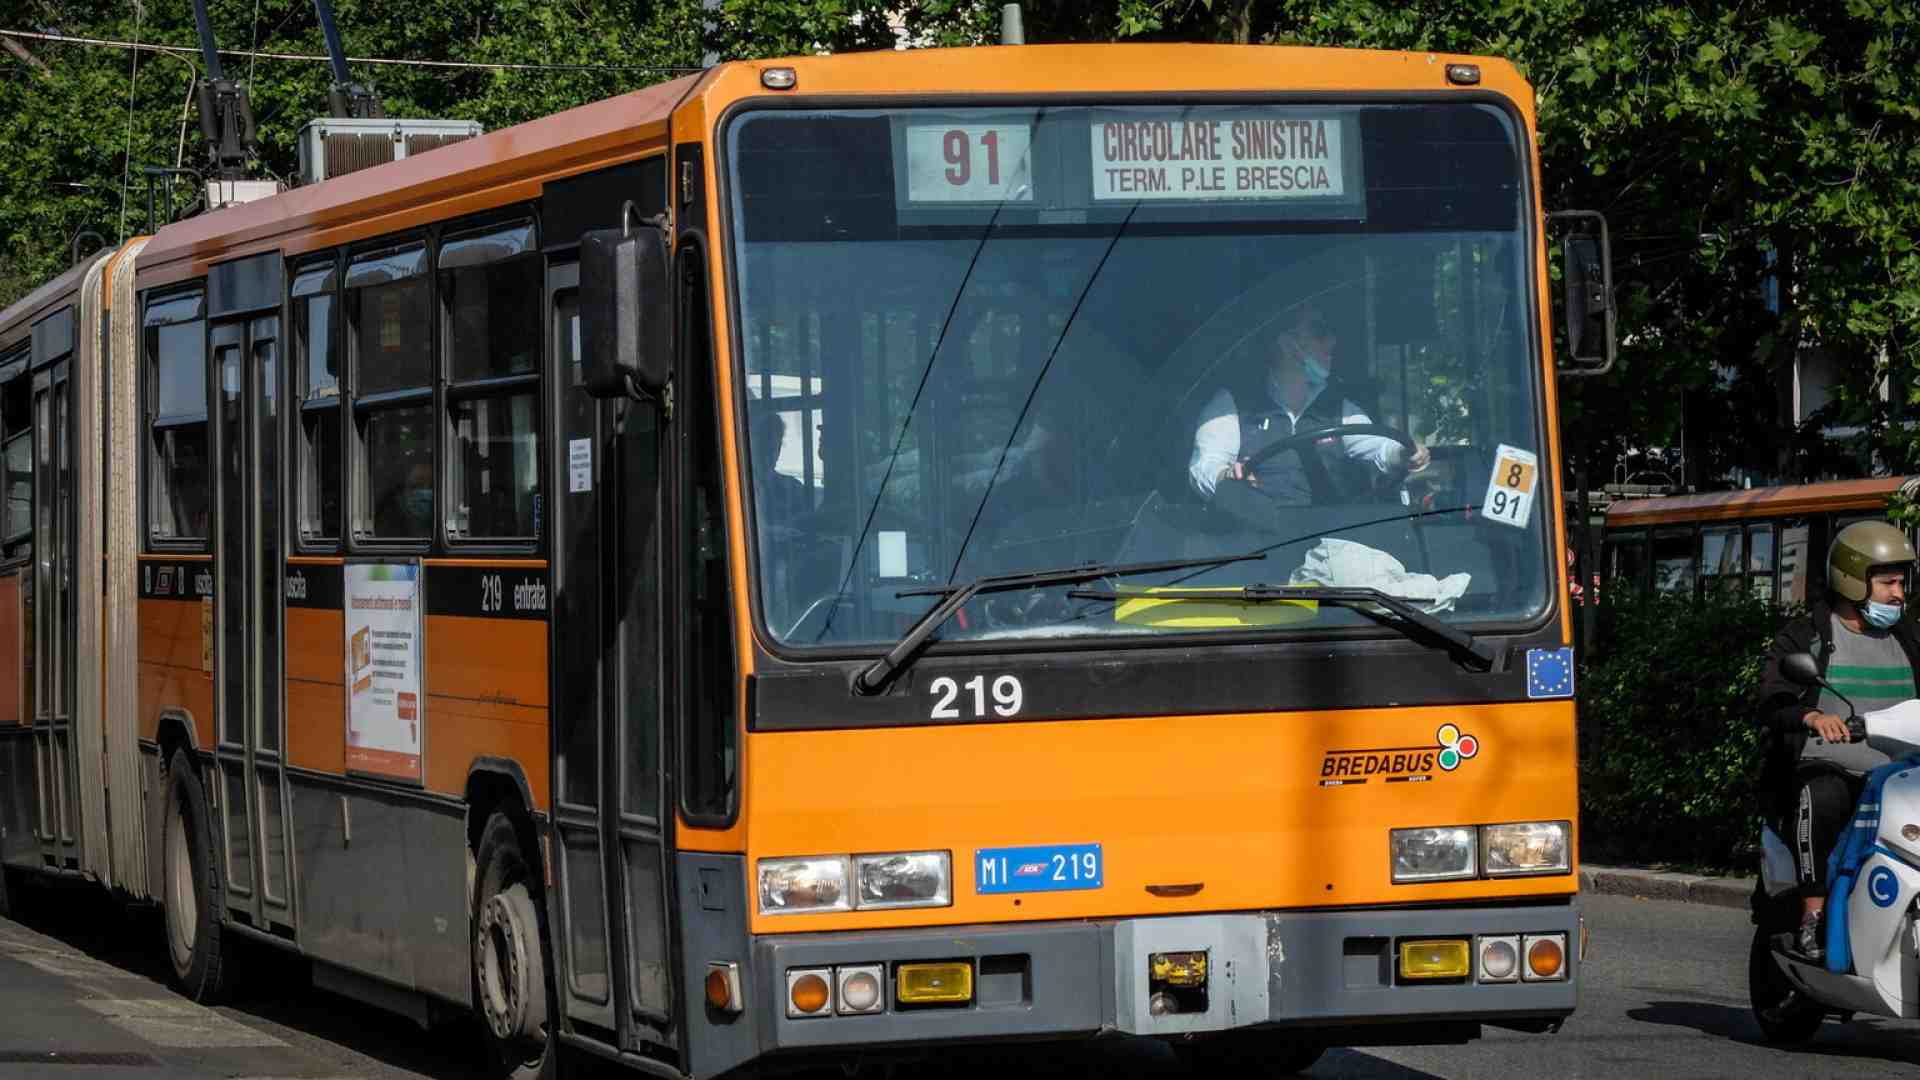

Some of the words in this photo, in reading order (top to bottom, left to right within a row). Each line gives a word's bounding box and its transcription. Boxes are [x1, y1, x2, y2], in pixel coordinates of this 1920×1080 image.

[943, 129, 1000, 186] 91
[1103, 120, 1222, 162] CIRCOLARE
[1231, 120, 1328, 161] SINISTRA
[1105, 168, 1171, 192] TERM.
[1182, 167, 1225, 191] P.LE
[1236, 165, 1330, 191] BRESCIA
[1507, 463, 1522, 488] 8
[1492, 491, 1521, 519] 91
[481, 575, 502, 612] 219
[513, 576, 546, 610] entrata
[929, 675, 1023, 719] 219
[1321, 752, 1434, 777] BREDABUS
[981, 857, 1008, 886] MI
[1052, 852, 1096, 881] 219
